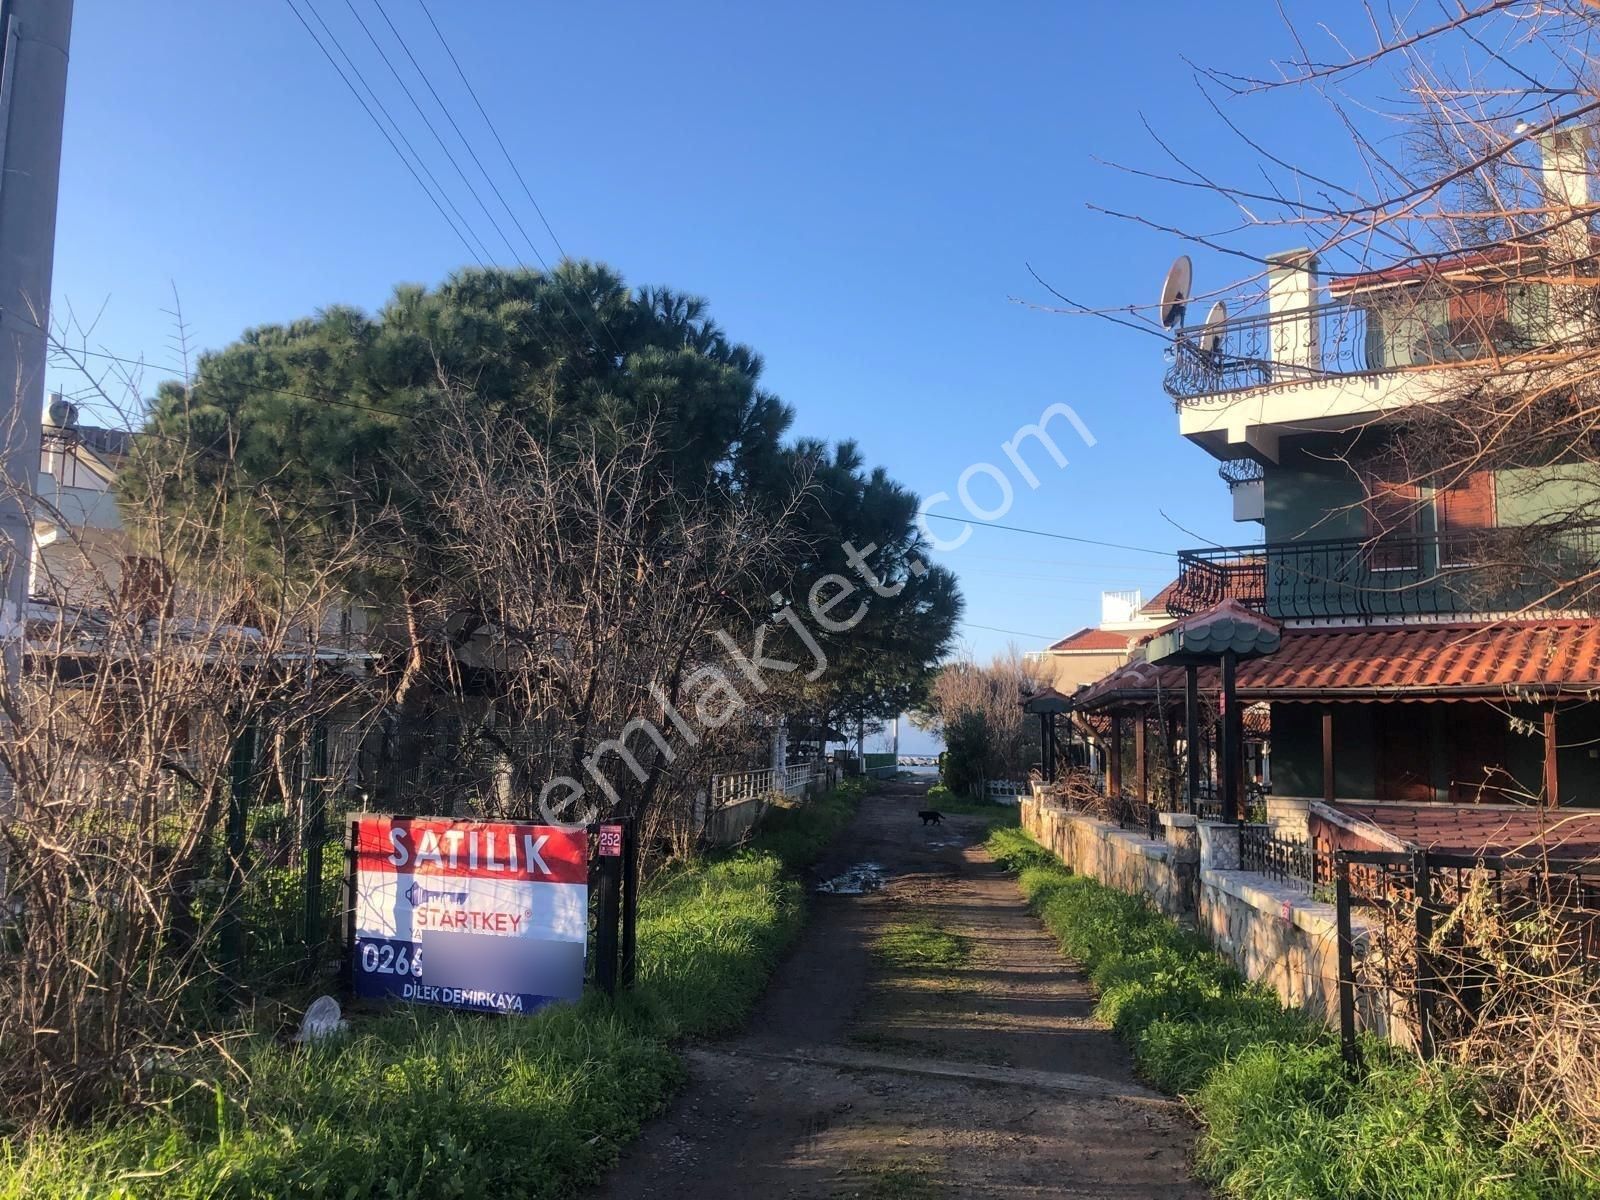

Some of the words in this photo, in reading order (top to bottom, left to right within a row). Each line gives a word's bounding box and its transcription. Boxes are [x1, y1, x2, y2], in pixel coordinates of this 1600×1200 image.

[388, 827, 552, 875] SATILIK
[601, 832, 620, 846] 252
[417, 906, 521, 933] STARTKEY
